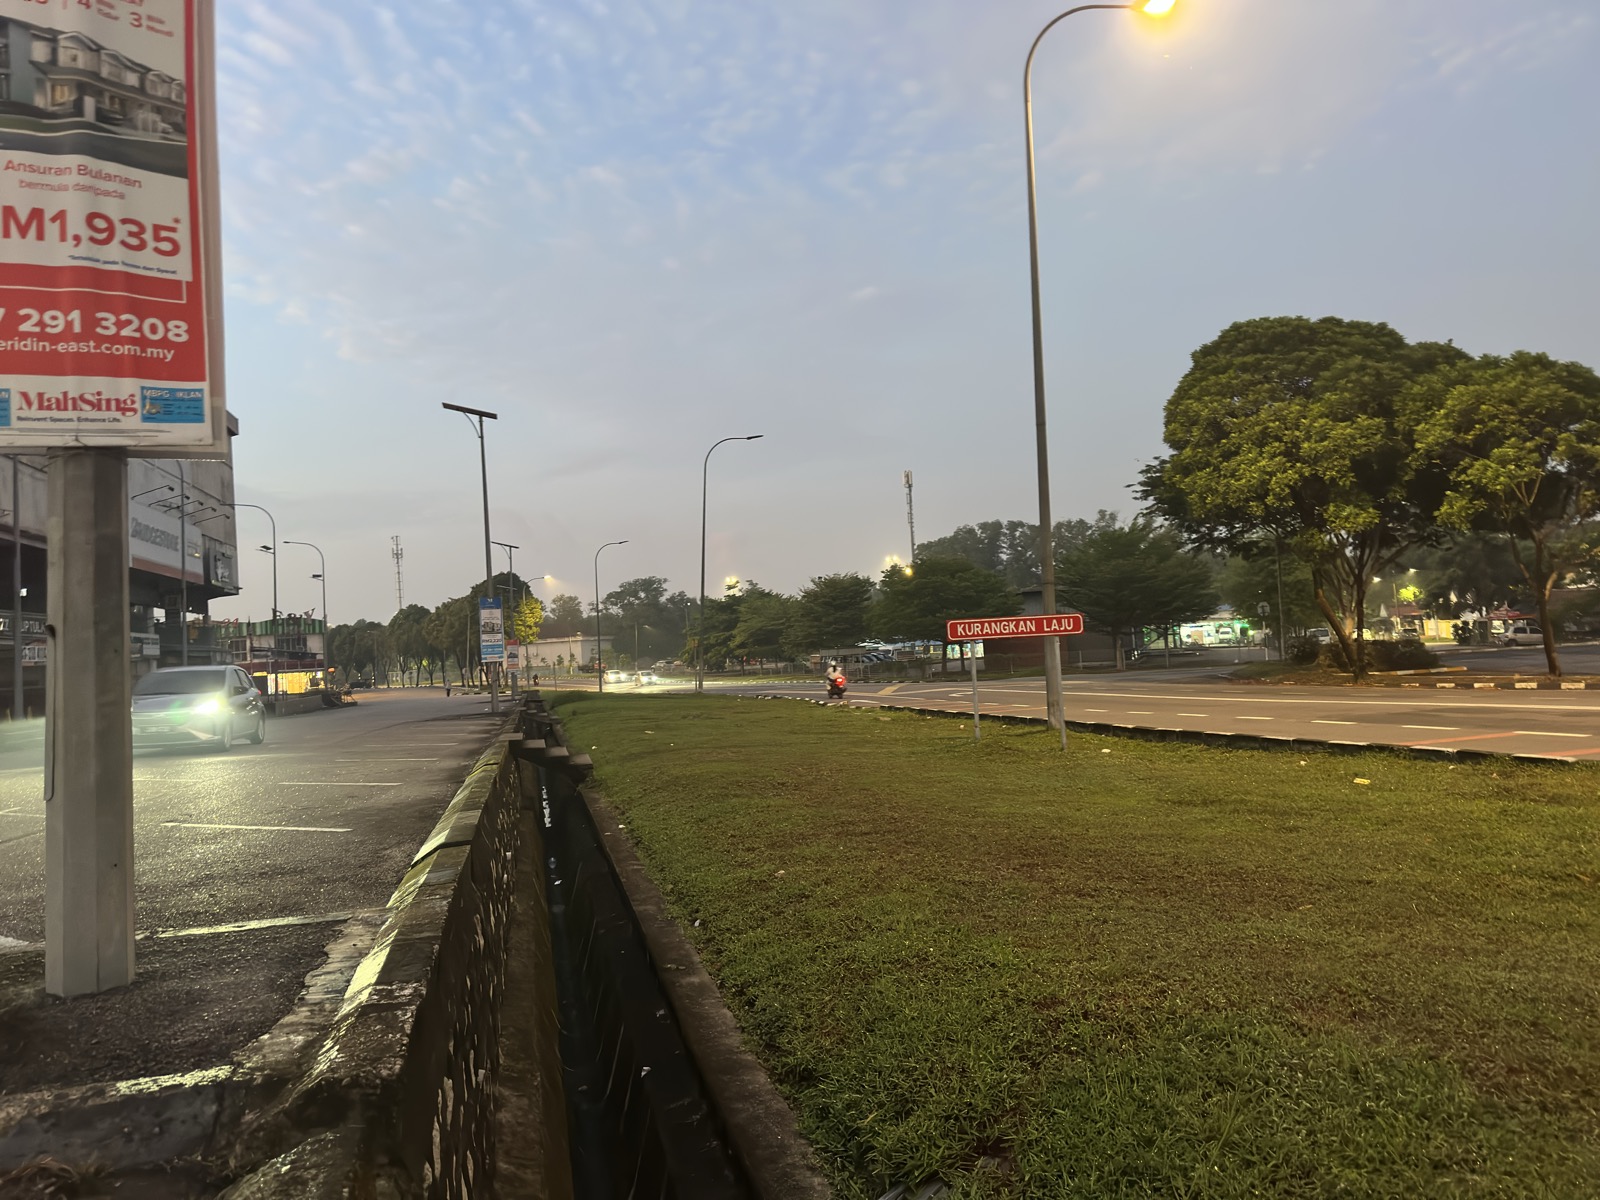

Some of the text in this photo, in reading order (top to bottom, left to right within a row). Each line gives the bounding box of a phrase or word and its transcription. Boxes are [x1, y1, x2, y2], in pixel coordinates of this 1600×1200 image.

[129, 12, 143, 28] 3
[4, 160, 142, 188] Ansuran Bulanan
[17, 308, 82, 333] 291
[95, 312, 189, 342] 3208
[0, 337, 175, 362] eridin-east.com.my
[16, 391, 138, 417] MahSing
[957, 619, 1074, 636] KURANGKAN LAJU
